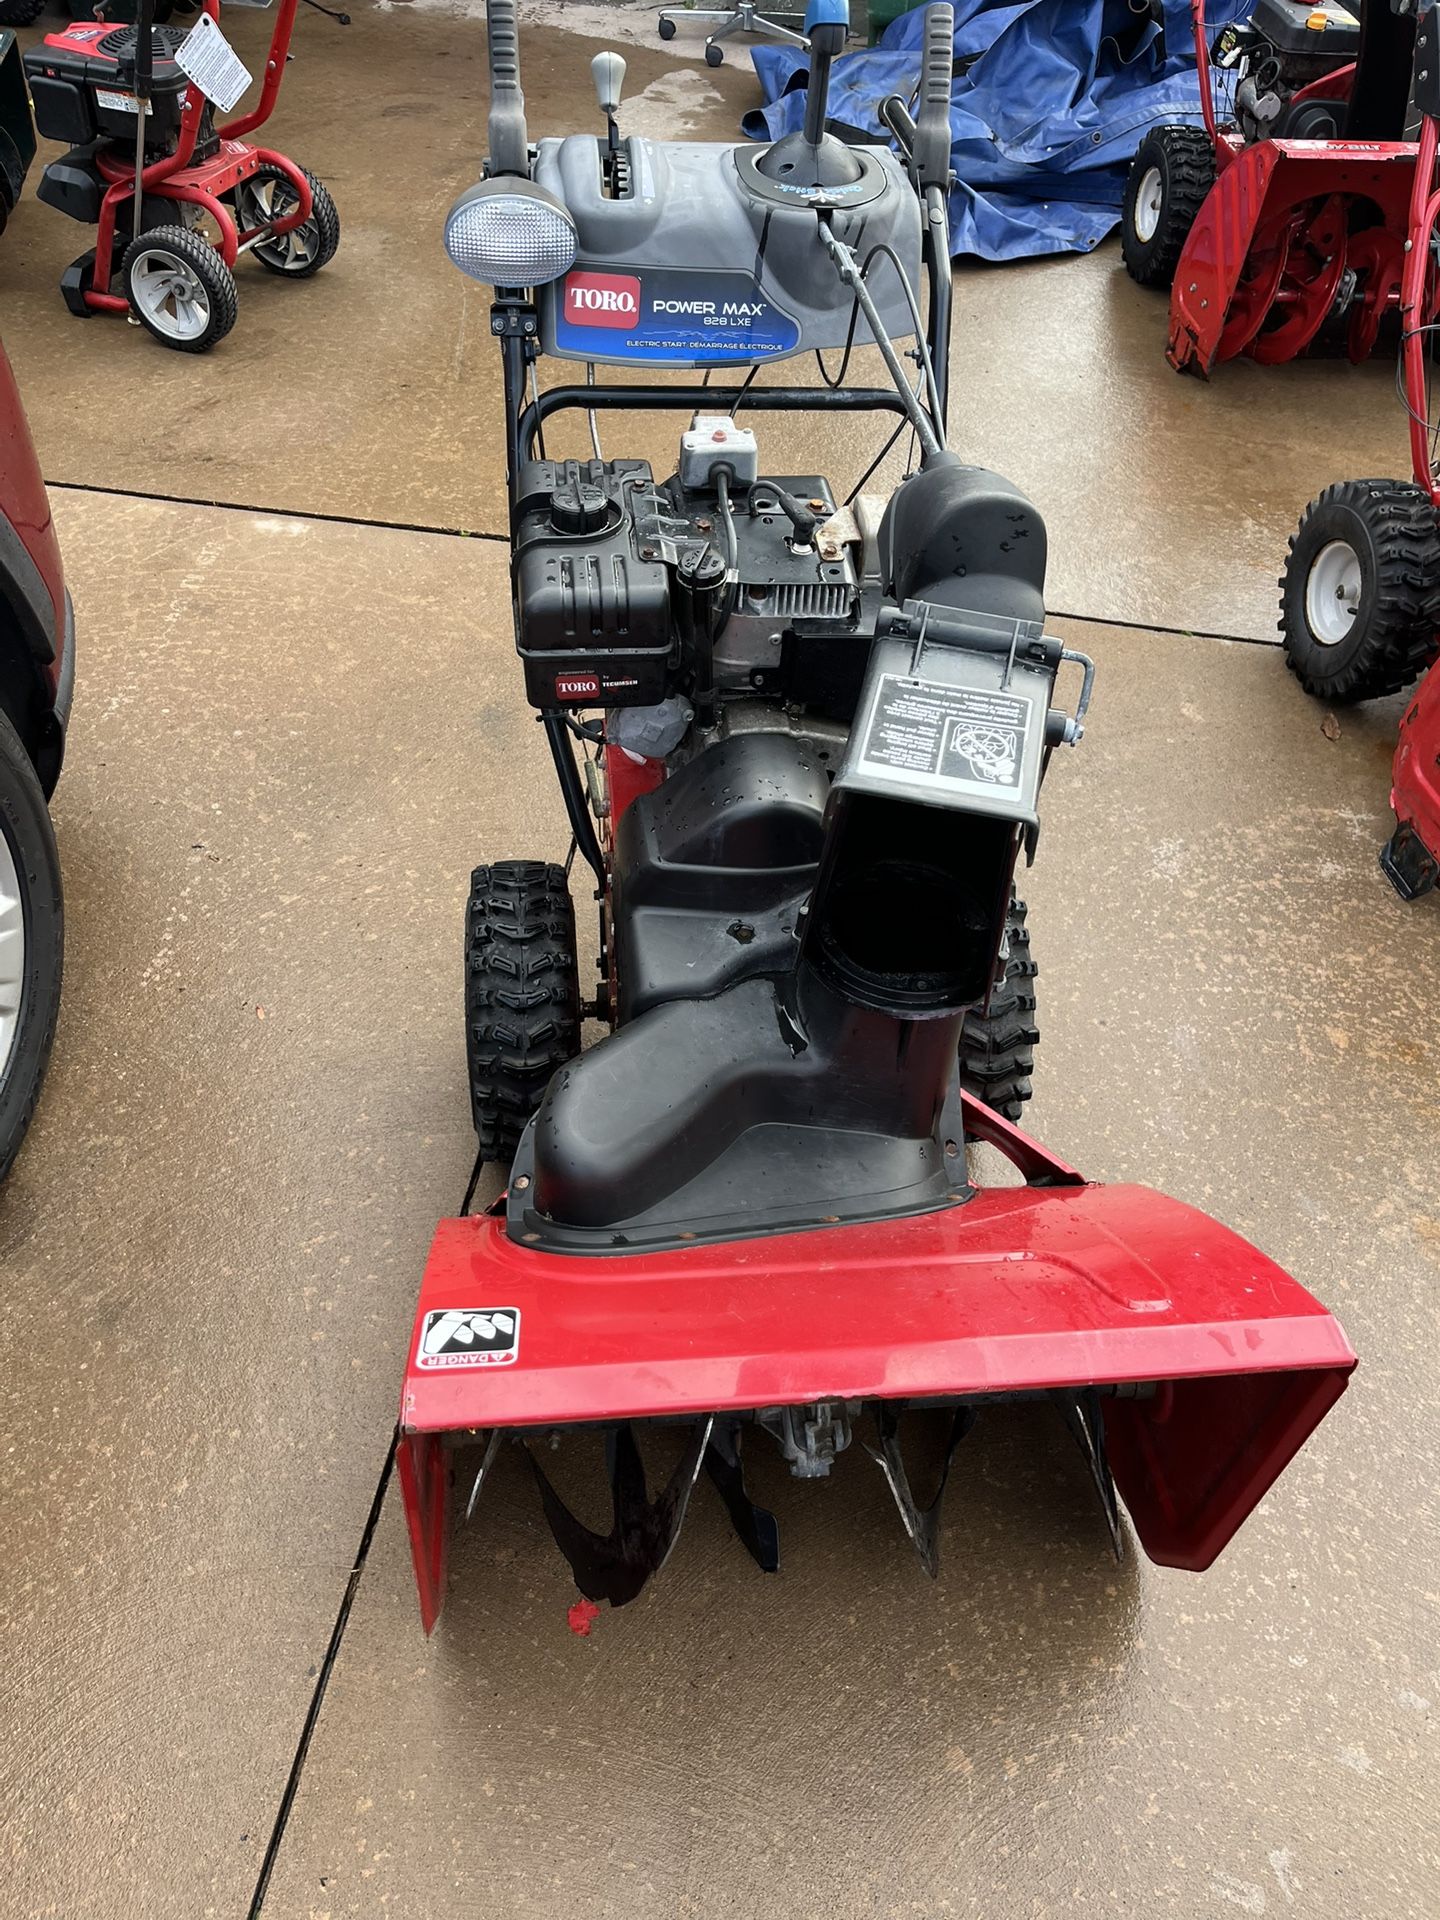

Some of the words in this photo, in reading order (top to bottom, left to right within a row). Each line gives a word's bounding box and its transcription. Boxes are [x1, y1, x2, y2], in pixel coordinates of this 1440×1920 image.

[653, 300, 716, 315] POWER
[722, 301, 763, 316] MAX
[703, 316, 728, 326] 828
[730, 317, 752, 327] LXE
[626, 340, 661, 348] ELECTRIC
[689, 341, 739, 350] DÉMARRAGE
[739, 342, 783, 351] ÉLECTRIQUE
[558, 681, 597, 693] TORO
[427, 1353, 489, 1366] DANGER
